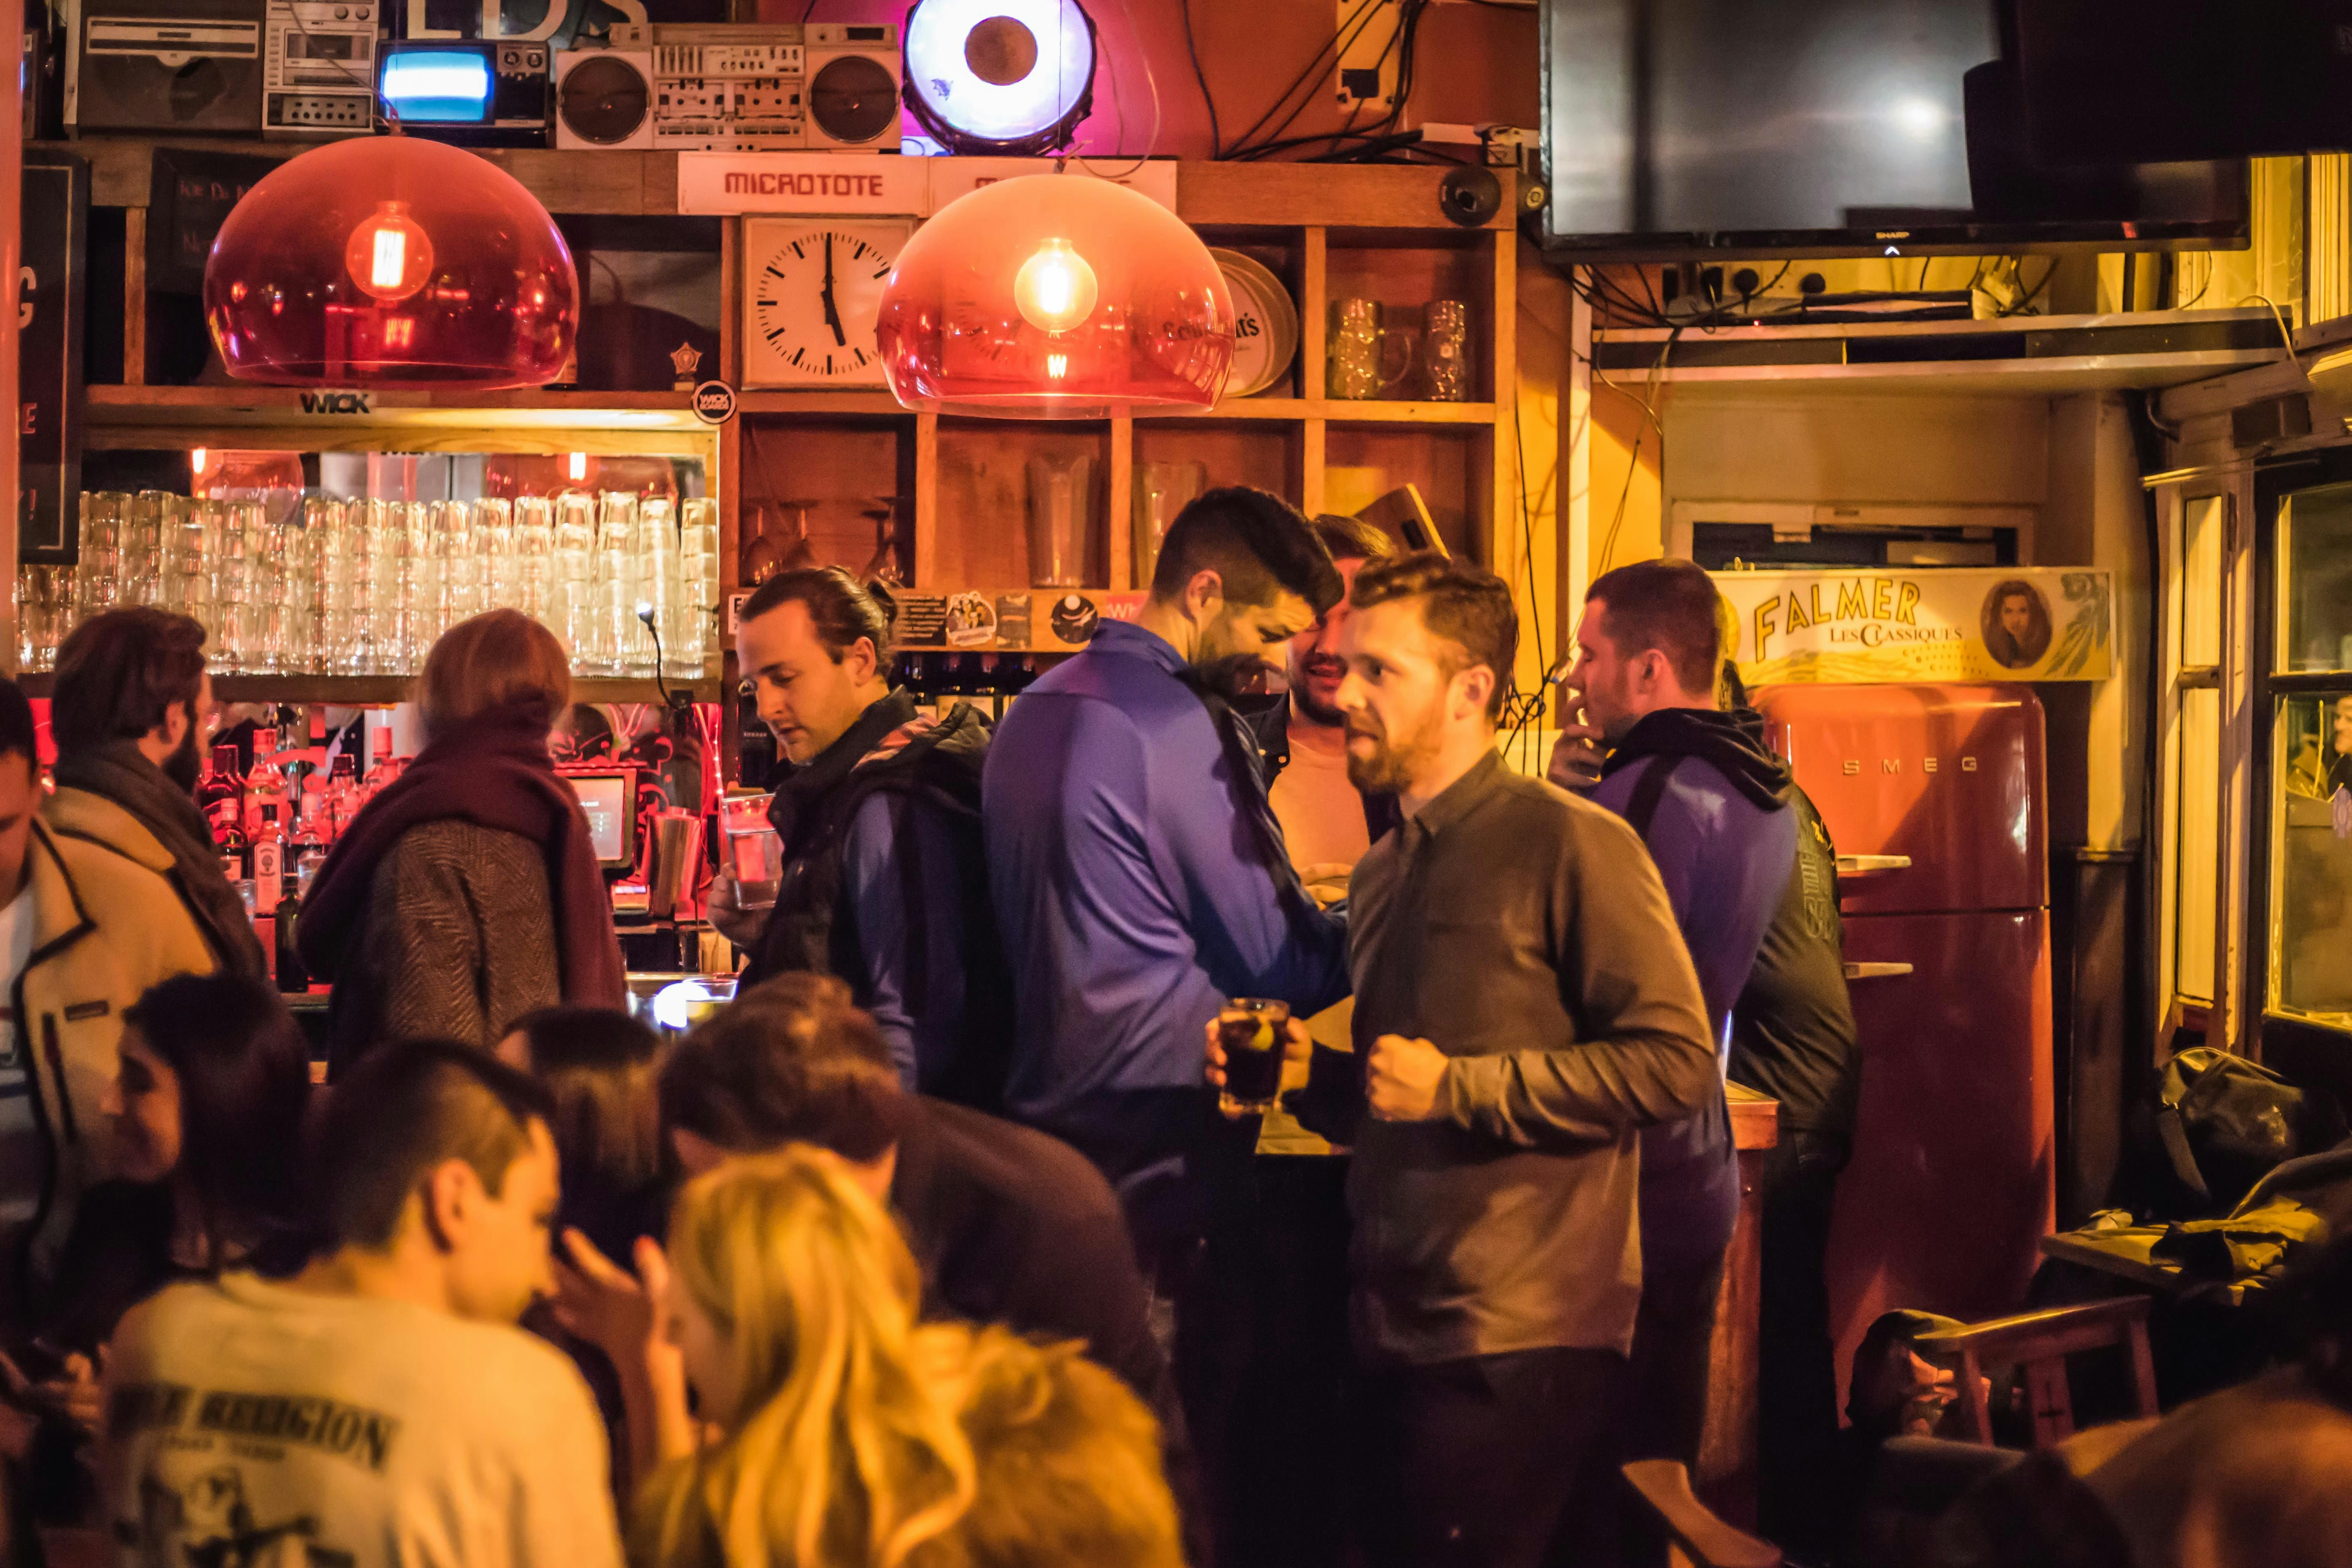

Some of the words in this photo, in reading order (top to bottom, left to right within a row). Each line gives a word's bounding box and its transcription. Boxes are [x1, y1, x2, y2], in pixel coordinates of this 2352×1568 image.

[724, 172, 884, 196] MICROTOTE
[300, 393, 370, 414] WICK
[1753, 578, 1921, 665] FALMER
[1843, 756, 1977, 775] SMEG
[198, 1389, 402, 1470] RELIGION
